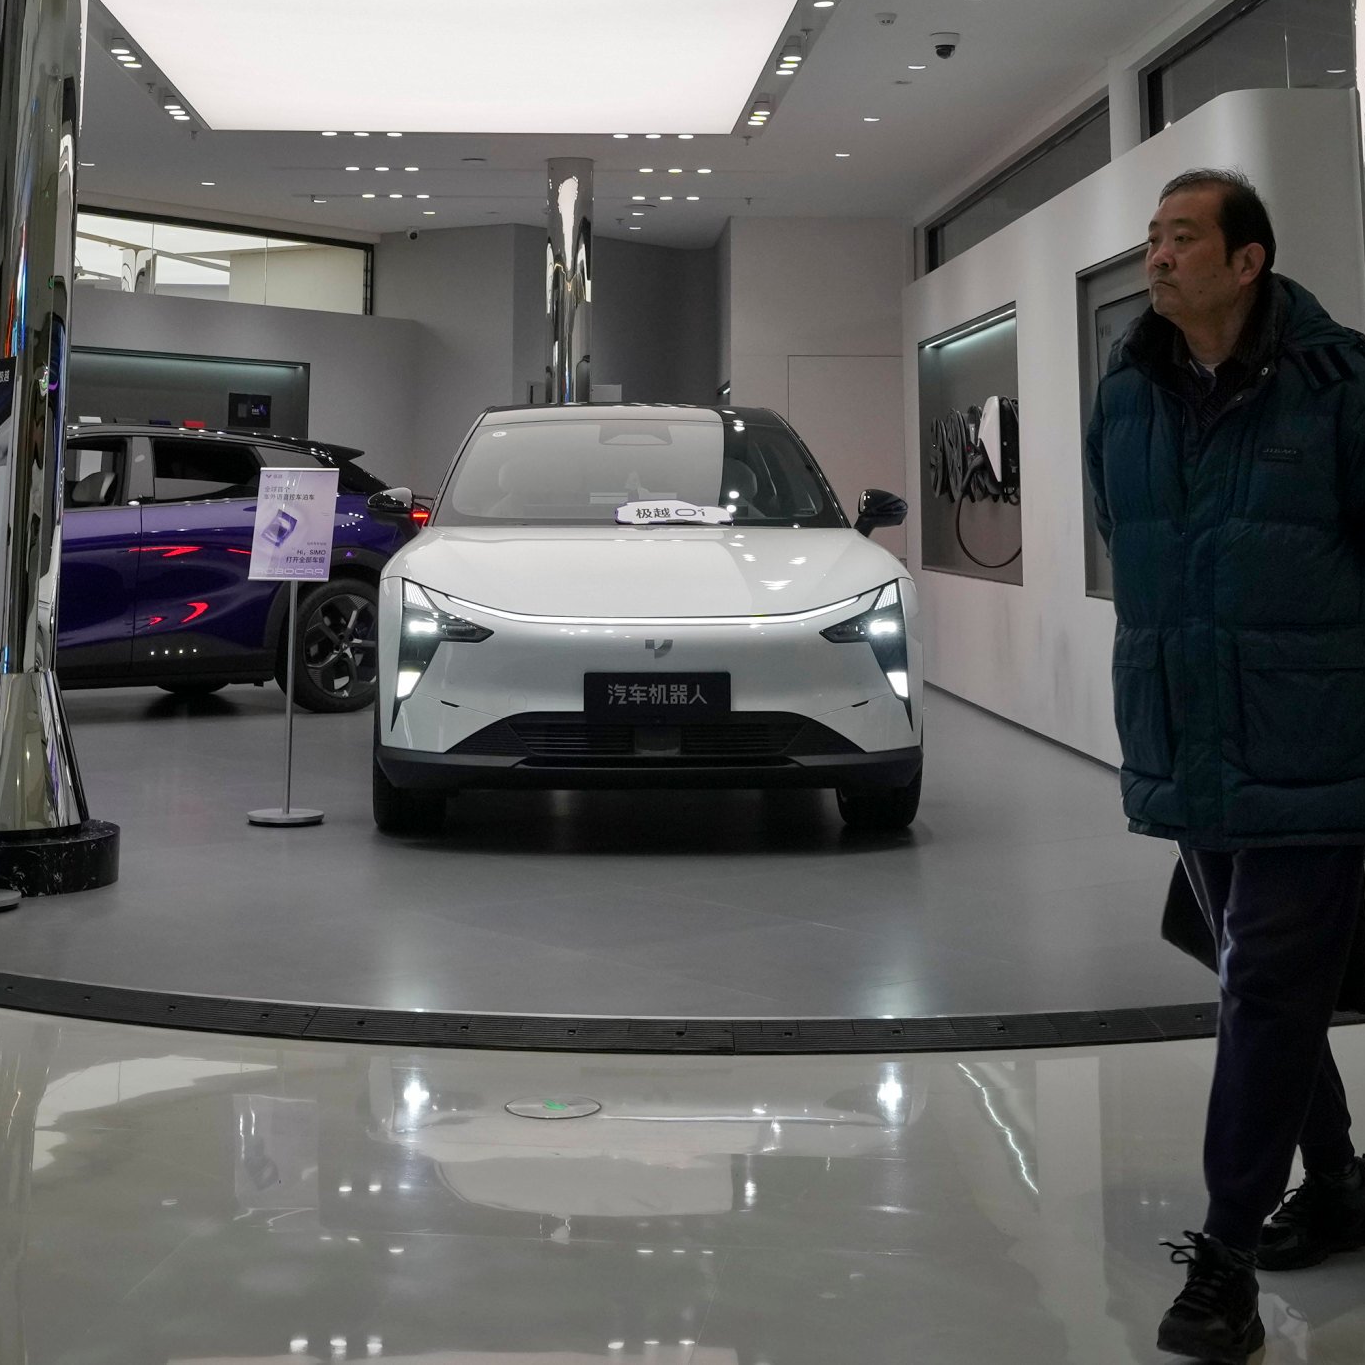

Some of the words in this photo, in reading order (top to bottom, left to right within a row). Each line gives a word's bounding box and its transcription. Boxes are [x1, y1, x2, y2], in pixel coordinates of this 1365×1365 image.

[635, 507, 672, 519] 极越
[607, 683, 708, 706] 汽车机器人
